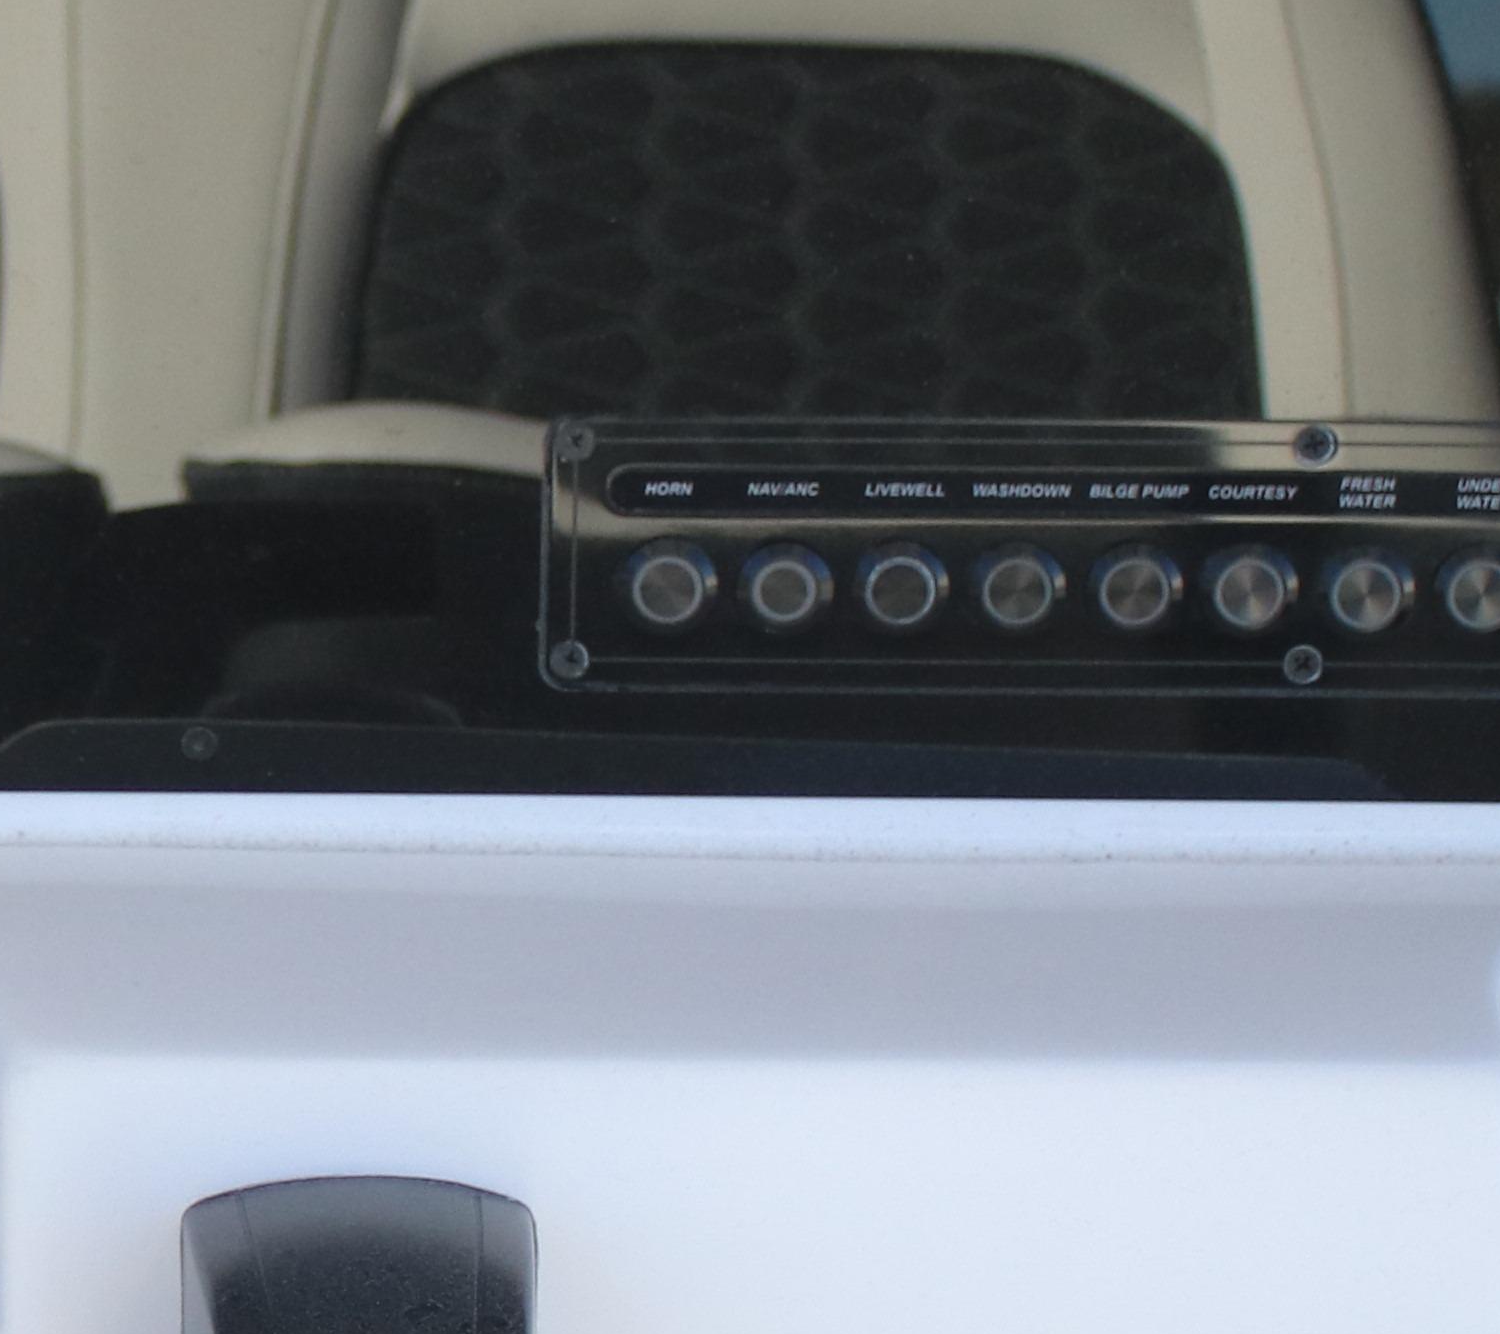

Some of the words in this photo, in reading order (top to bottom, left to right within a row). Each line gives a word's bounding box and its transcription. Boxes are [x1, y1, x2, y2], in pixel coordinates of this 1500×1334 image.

[645, 482, 693, 496] HORN
[865, 482, 945, 498] LIVEWELL
[972, 483, 1072, 499] WASHDOWN
[1089, 484, 1138, 500] BILGE
[1142, 485, 1190, 500] PUMP
[1208, 484, 1298, 501] COURTESY
[1340, 476, 1395, 493] FRESH
[1338, 493, 1396, 510] WATER
